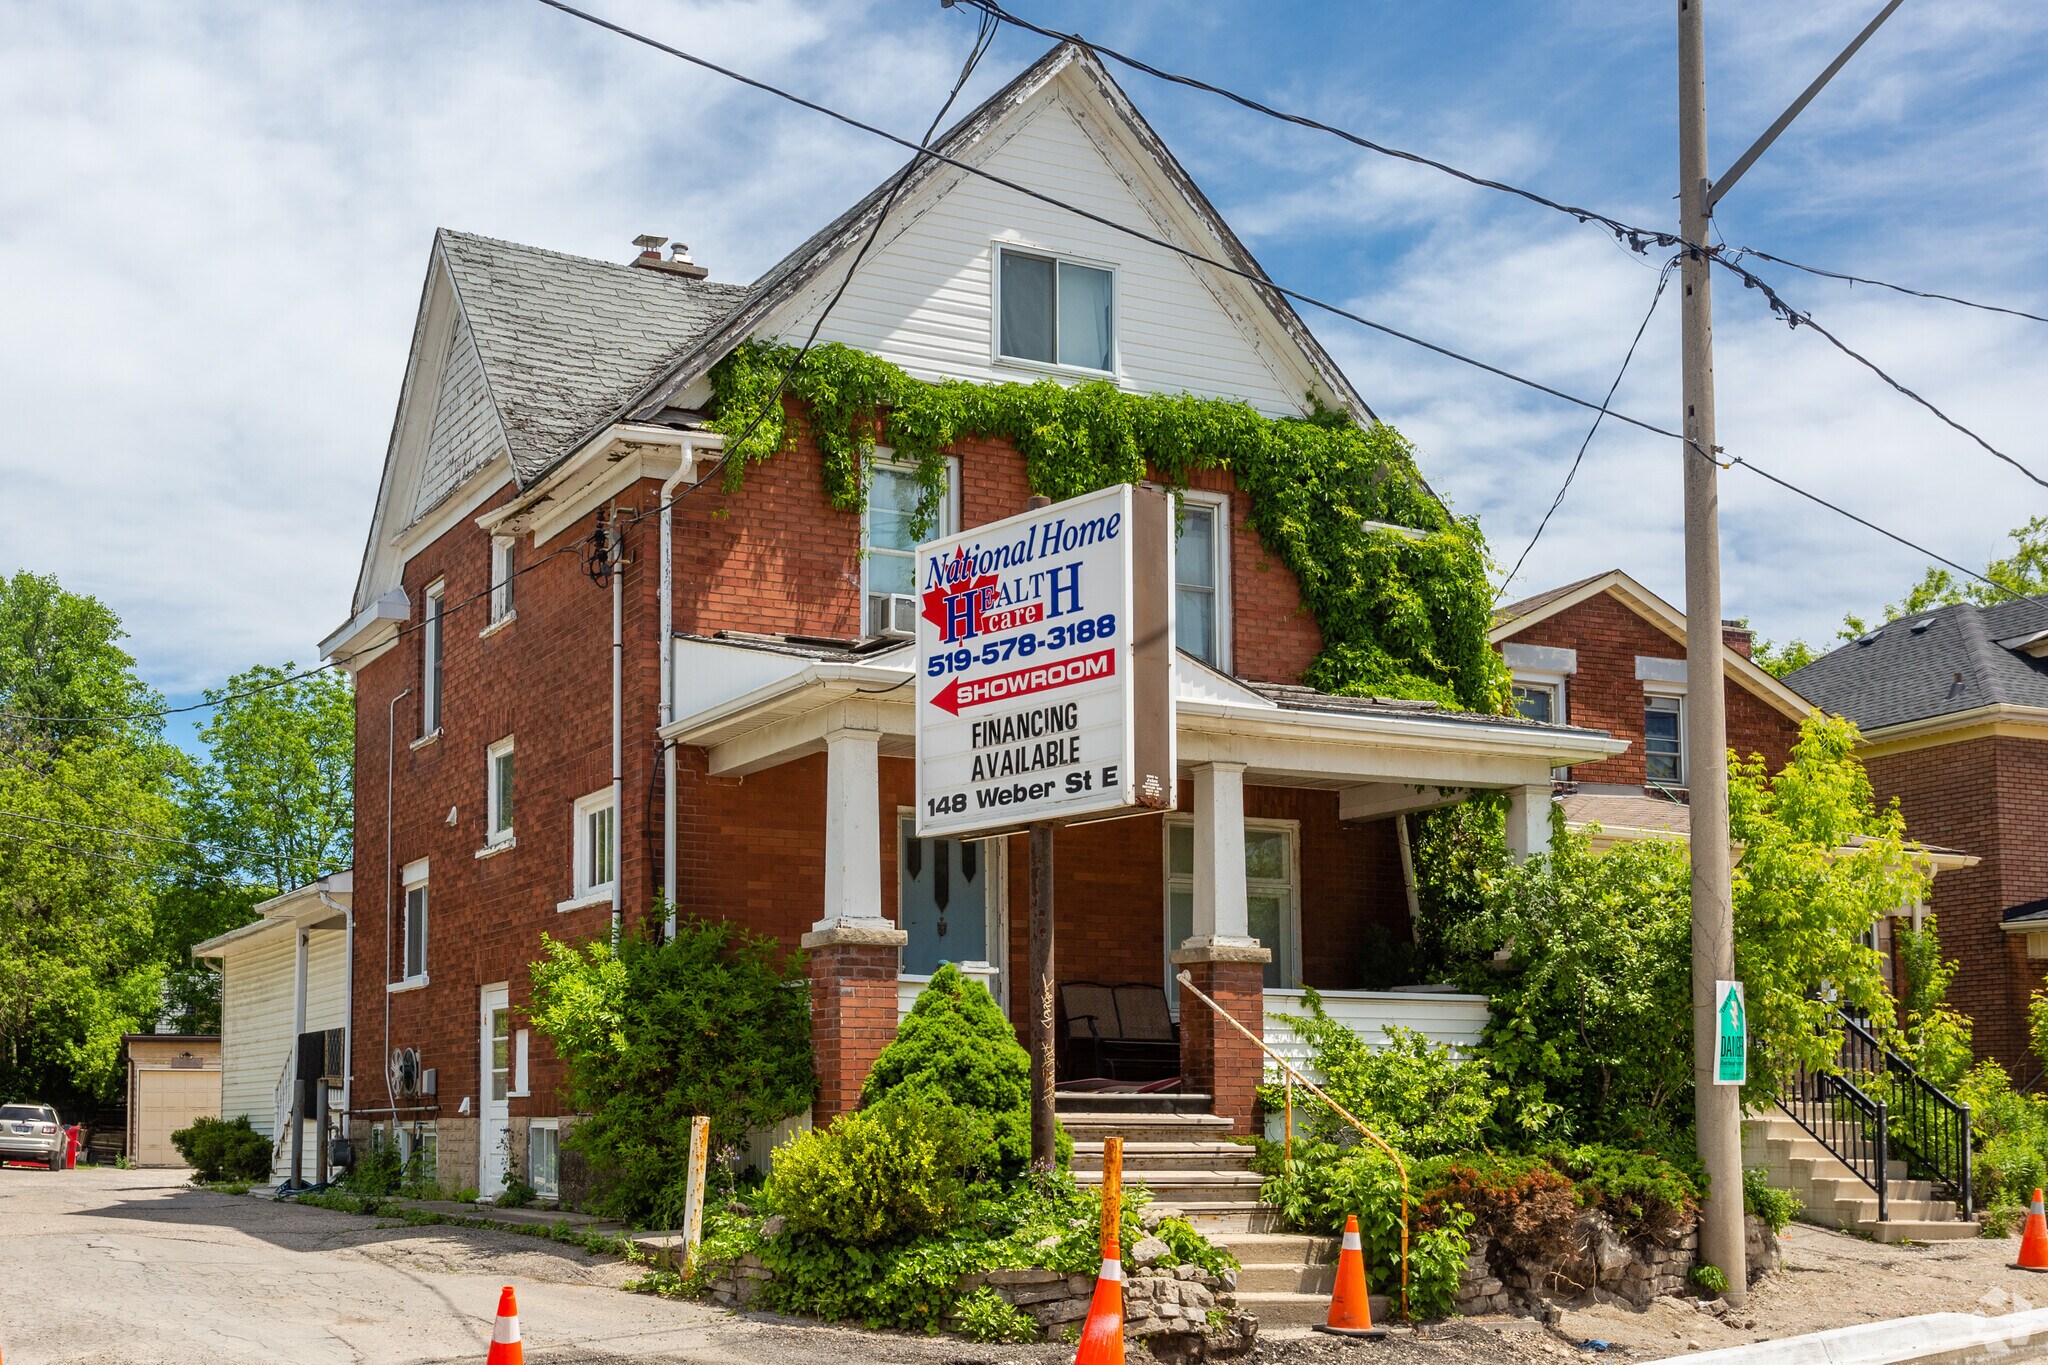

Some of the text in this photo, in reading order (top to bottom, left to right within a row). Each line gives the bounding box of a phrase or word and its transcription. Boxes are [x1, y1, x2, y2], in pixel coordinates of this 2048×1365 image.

[925, 512, 1121, 590] National Home
[988, 605, 1036, 632] care
[927, 614, 1116, 677] 519-578-3188
[957, 655, 1107, 704] SHOWROOM
[971, 702, 1078, 749] FINANCING
[971, 735, 1080, 782] AVAILABLE
[927, 793, 967, 817] 148
[976, 780, 1055, 809] Weber
[1065, 771, 1092, 794] St
[1102, 765, 1119, 787] E
